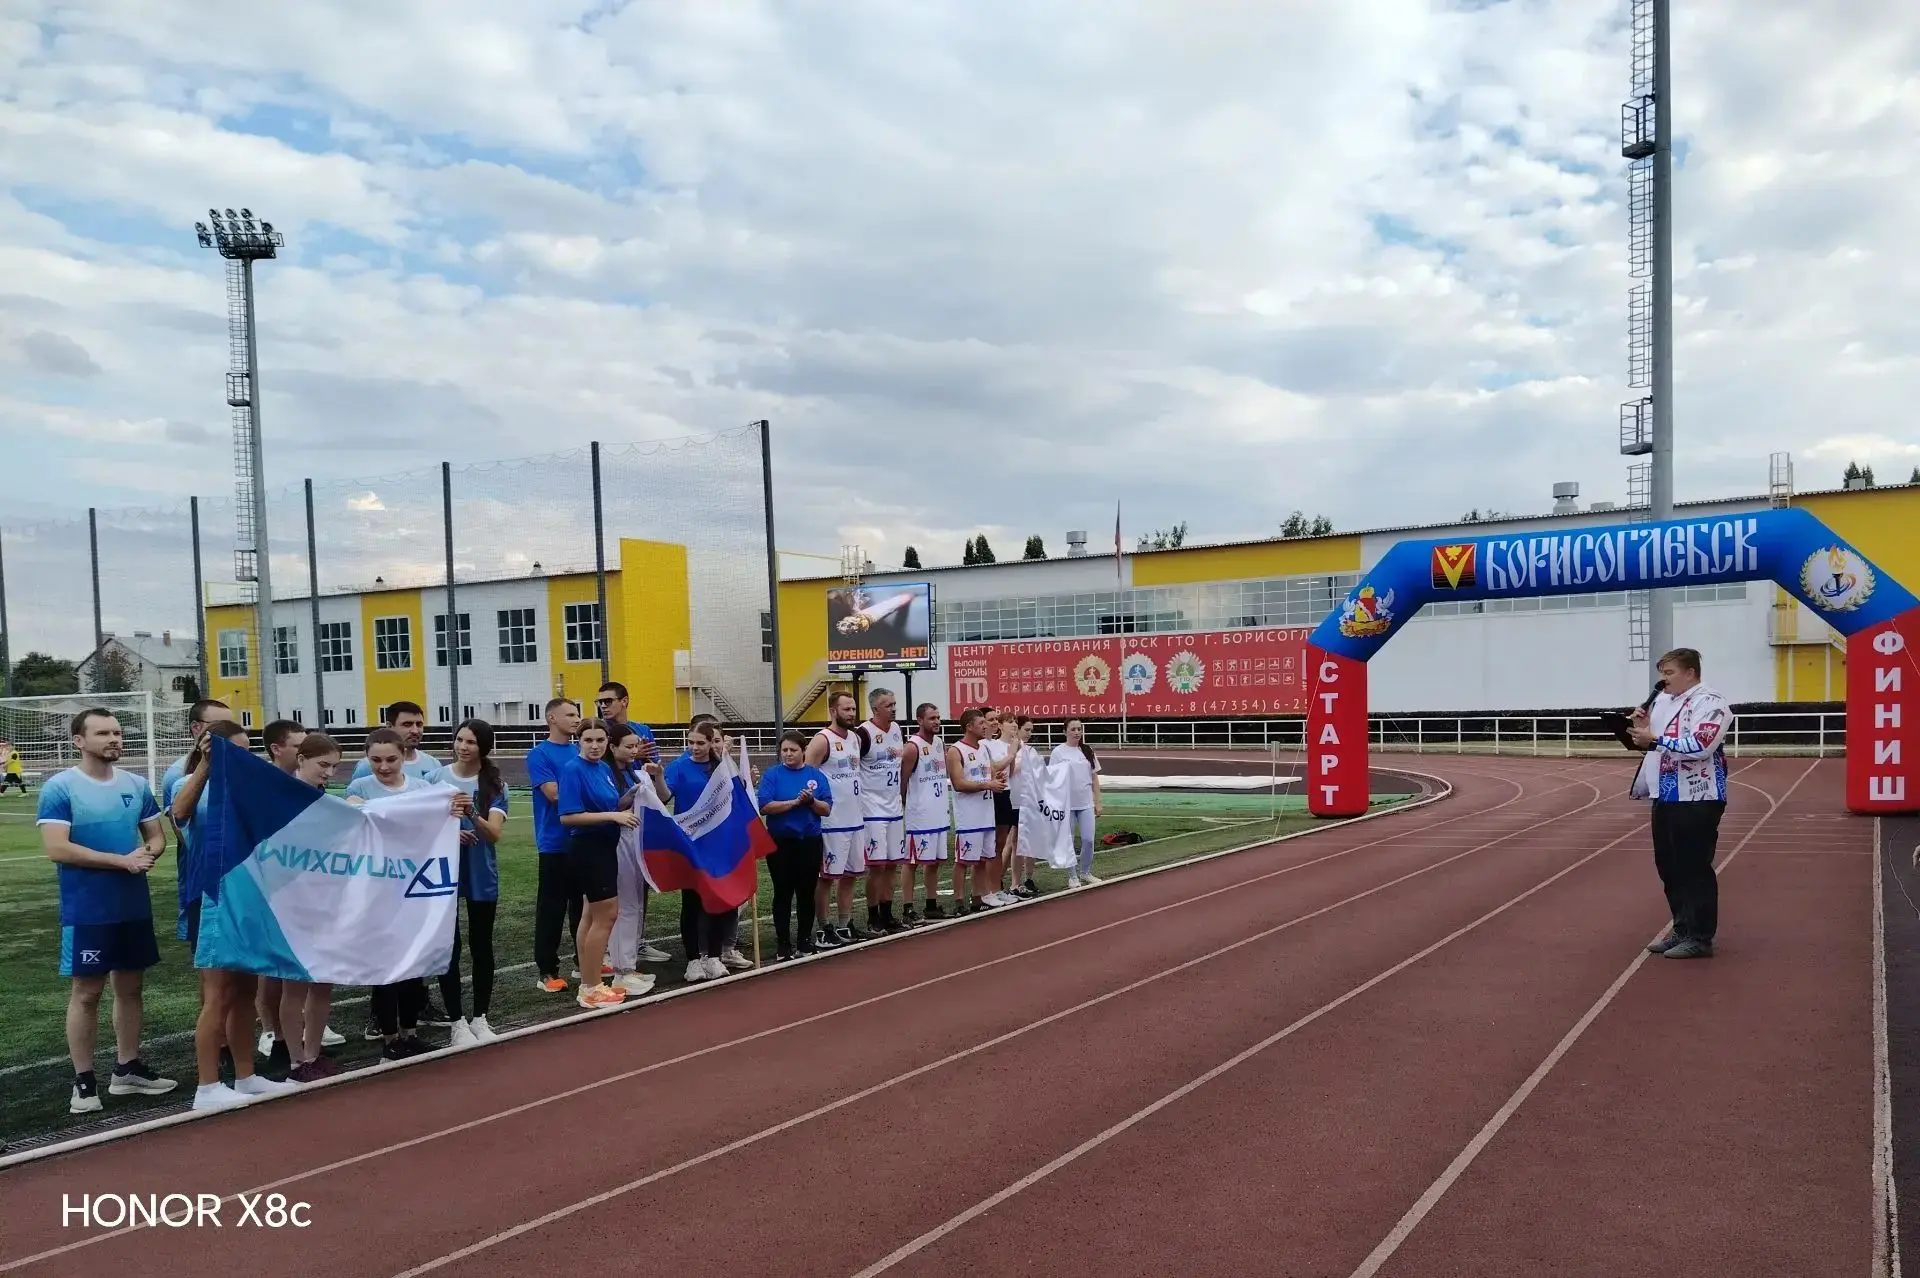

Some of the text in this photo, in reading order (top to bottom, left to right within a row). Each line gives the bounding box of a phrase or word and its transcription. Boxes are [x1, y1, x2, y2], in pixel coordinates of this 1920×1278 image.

[1485, 518, 1758, 591] БОРИСОГЛЕБСК
[829, 649, 885, 660] КУРЕНИЮ
[901, 646, 928, 658] НЕТ!
[953, 645, 994, 658] ЦЕНТР
[1001, 639, 1111, 655] ТЕСТИРОВАНИЯ
[1167, 635, 1195, 648] ГТО
[1204, 634, 1217, 646] Г.
[1222, 628, 1316, 645] БОРИСОГЛ
[954, 659, 987, 668] ВЫПОЛНИ
[954, 667, 988, 678] НОРМЫ
[955, 677, 989, 704] ГТО
[1869, 630, 1905, 801] ФИНИШ
[1319, 661, 1340, 806] СТАРТ
[853, 780, 859, 796] 8
[887, 770, 899, 787] 24
